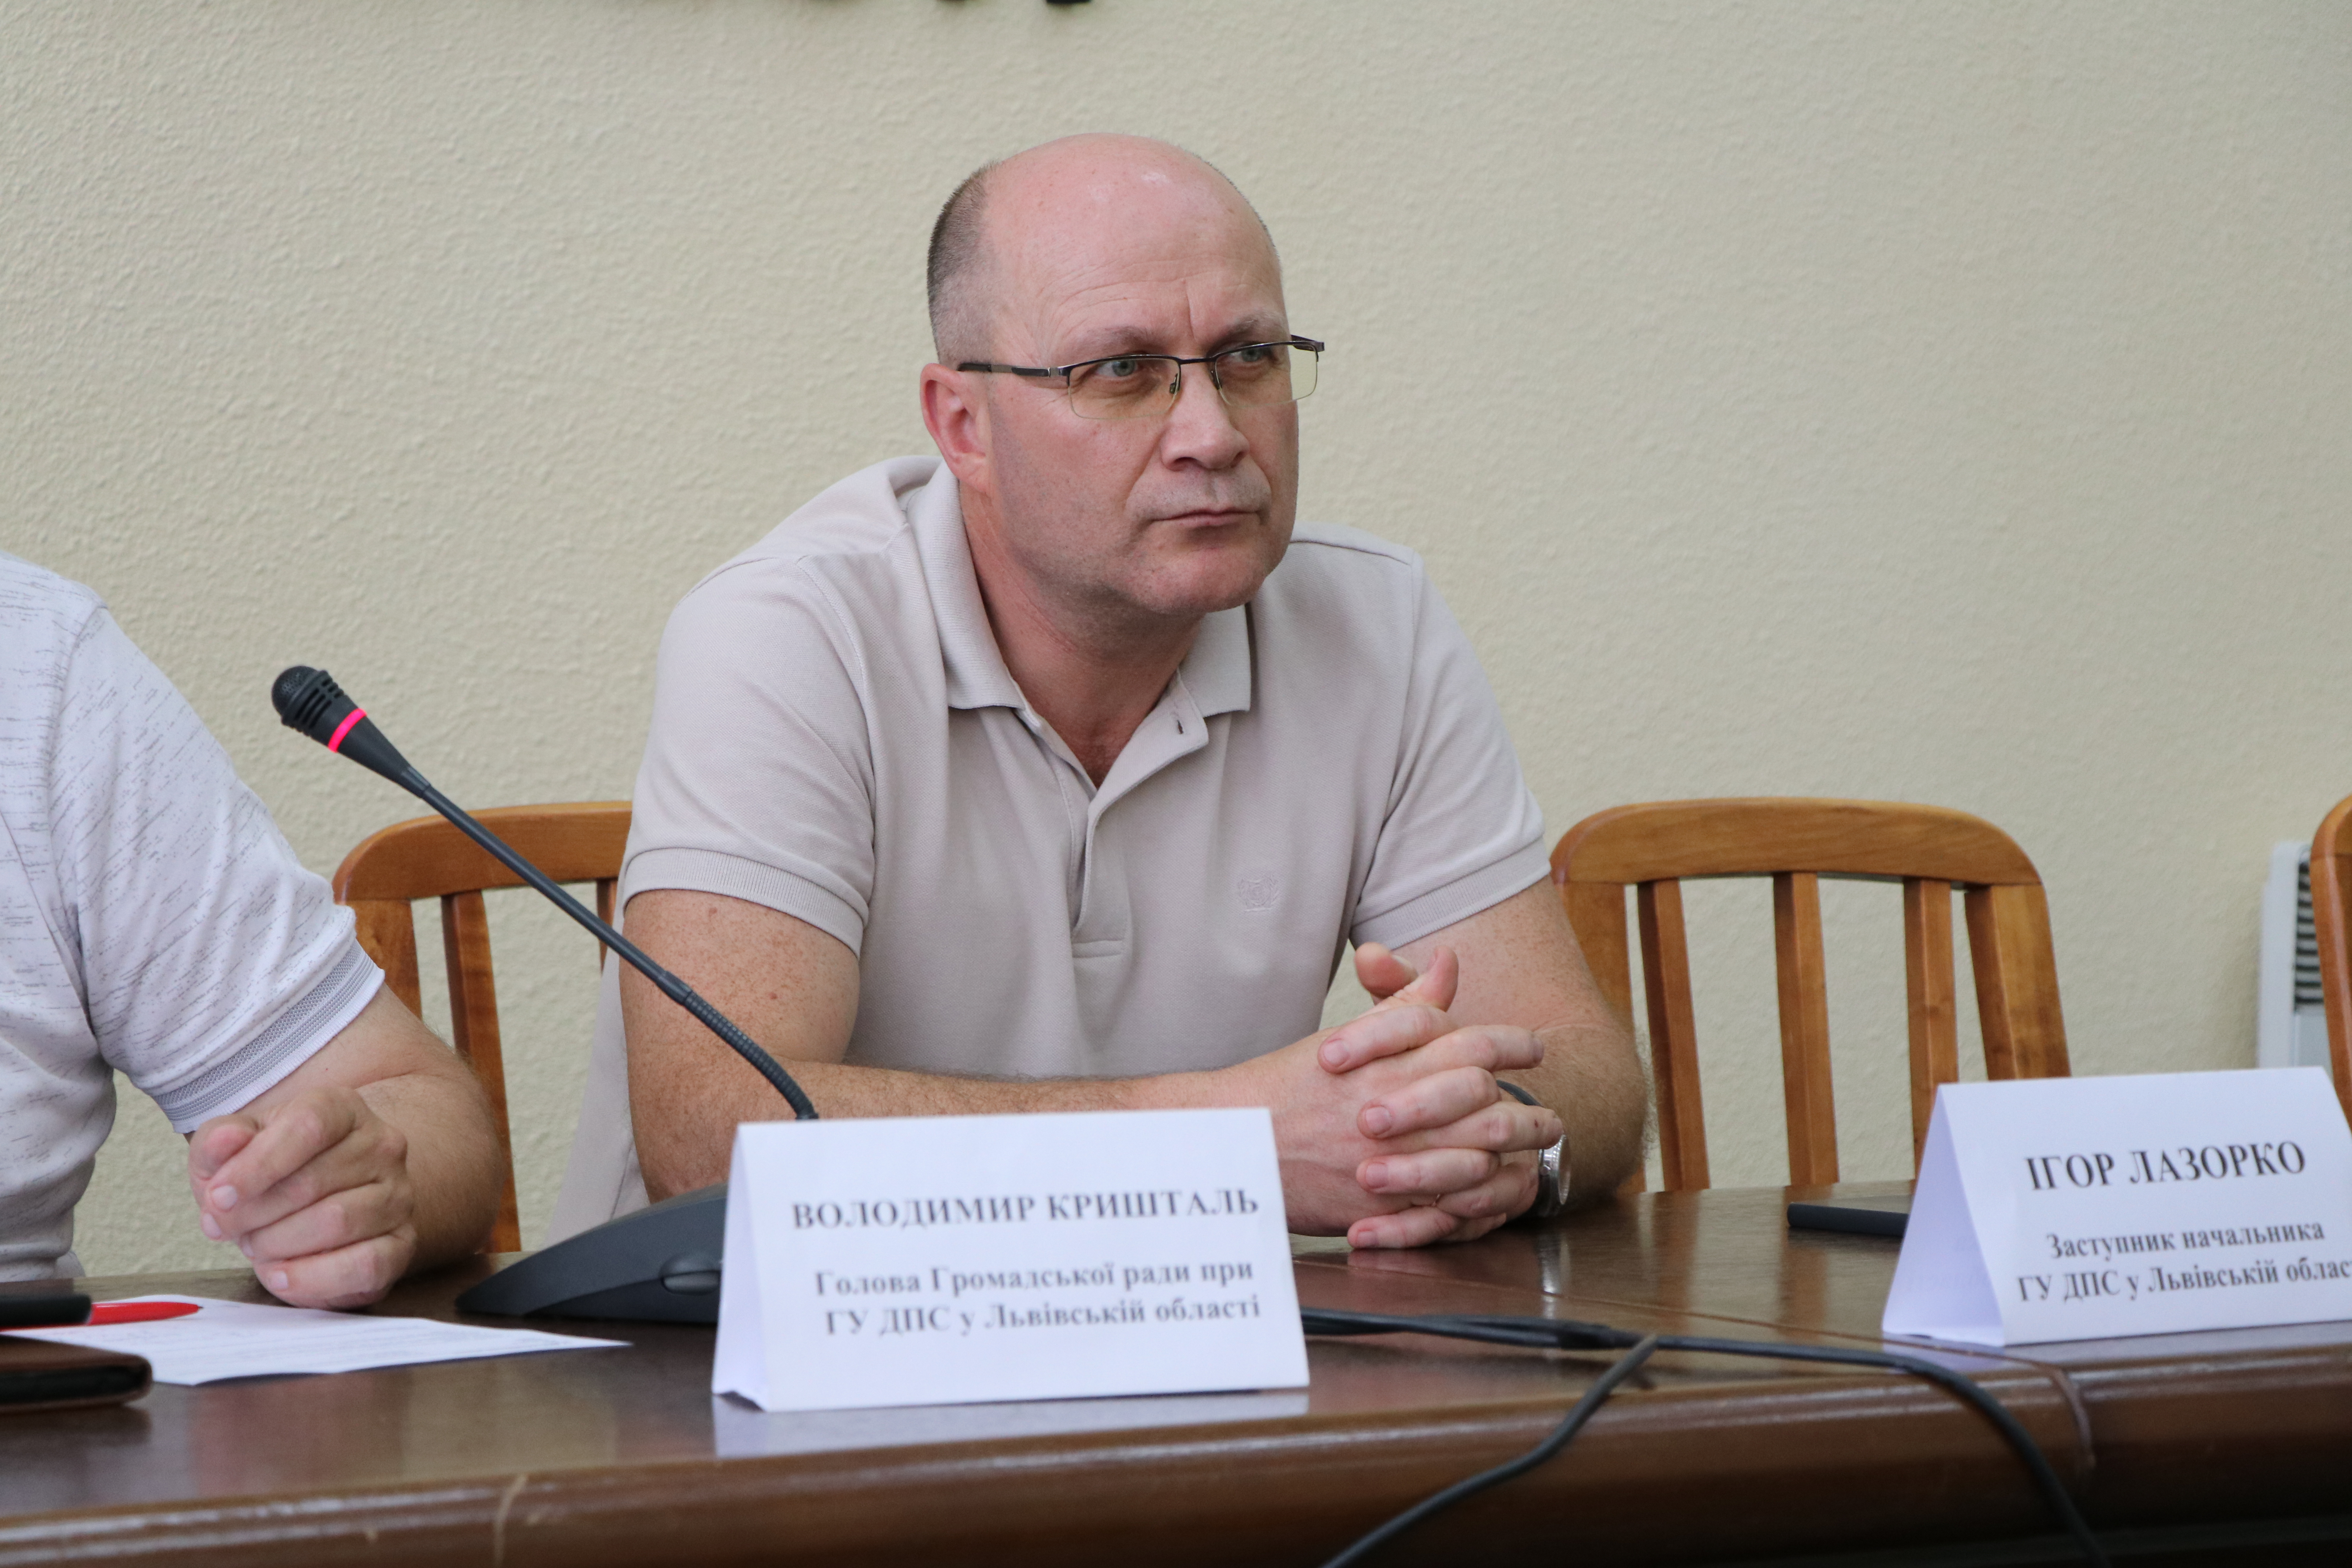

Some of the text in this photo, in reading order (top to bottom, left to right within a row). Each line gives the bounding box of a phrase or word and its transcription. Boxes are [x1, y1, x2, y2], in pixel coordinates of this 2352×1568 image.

[2025, 1140, 2306, 1191] ІГОР ЛАЗОРКО
[792, 1189, 1259, 1229] ВОЛОДИМИР КРИШТАЛЬ
[2046, 1222, 2326, 1261] Заступник начальника
[815, 1262, 1253, 1298] Голова Громадської ради при
[2018, 1256, 2352, 1303] ГУ ДПС у Львівській облас
[826, 1294, 1260, 1338] ГУ ДПС у Львівській області
